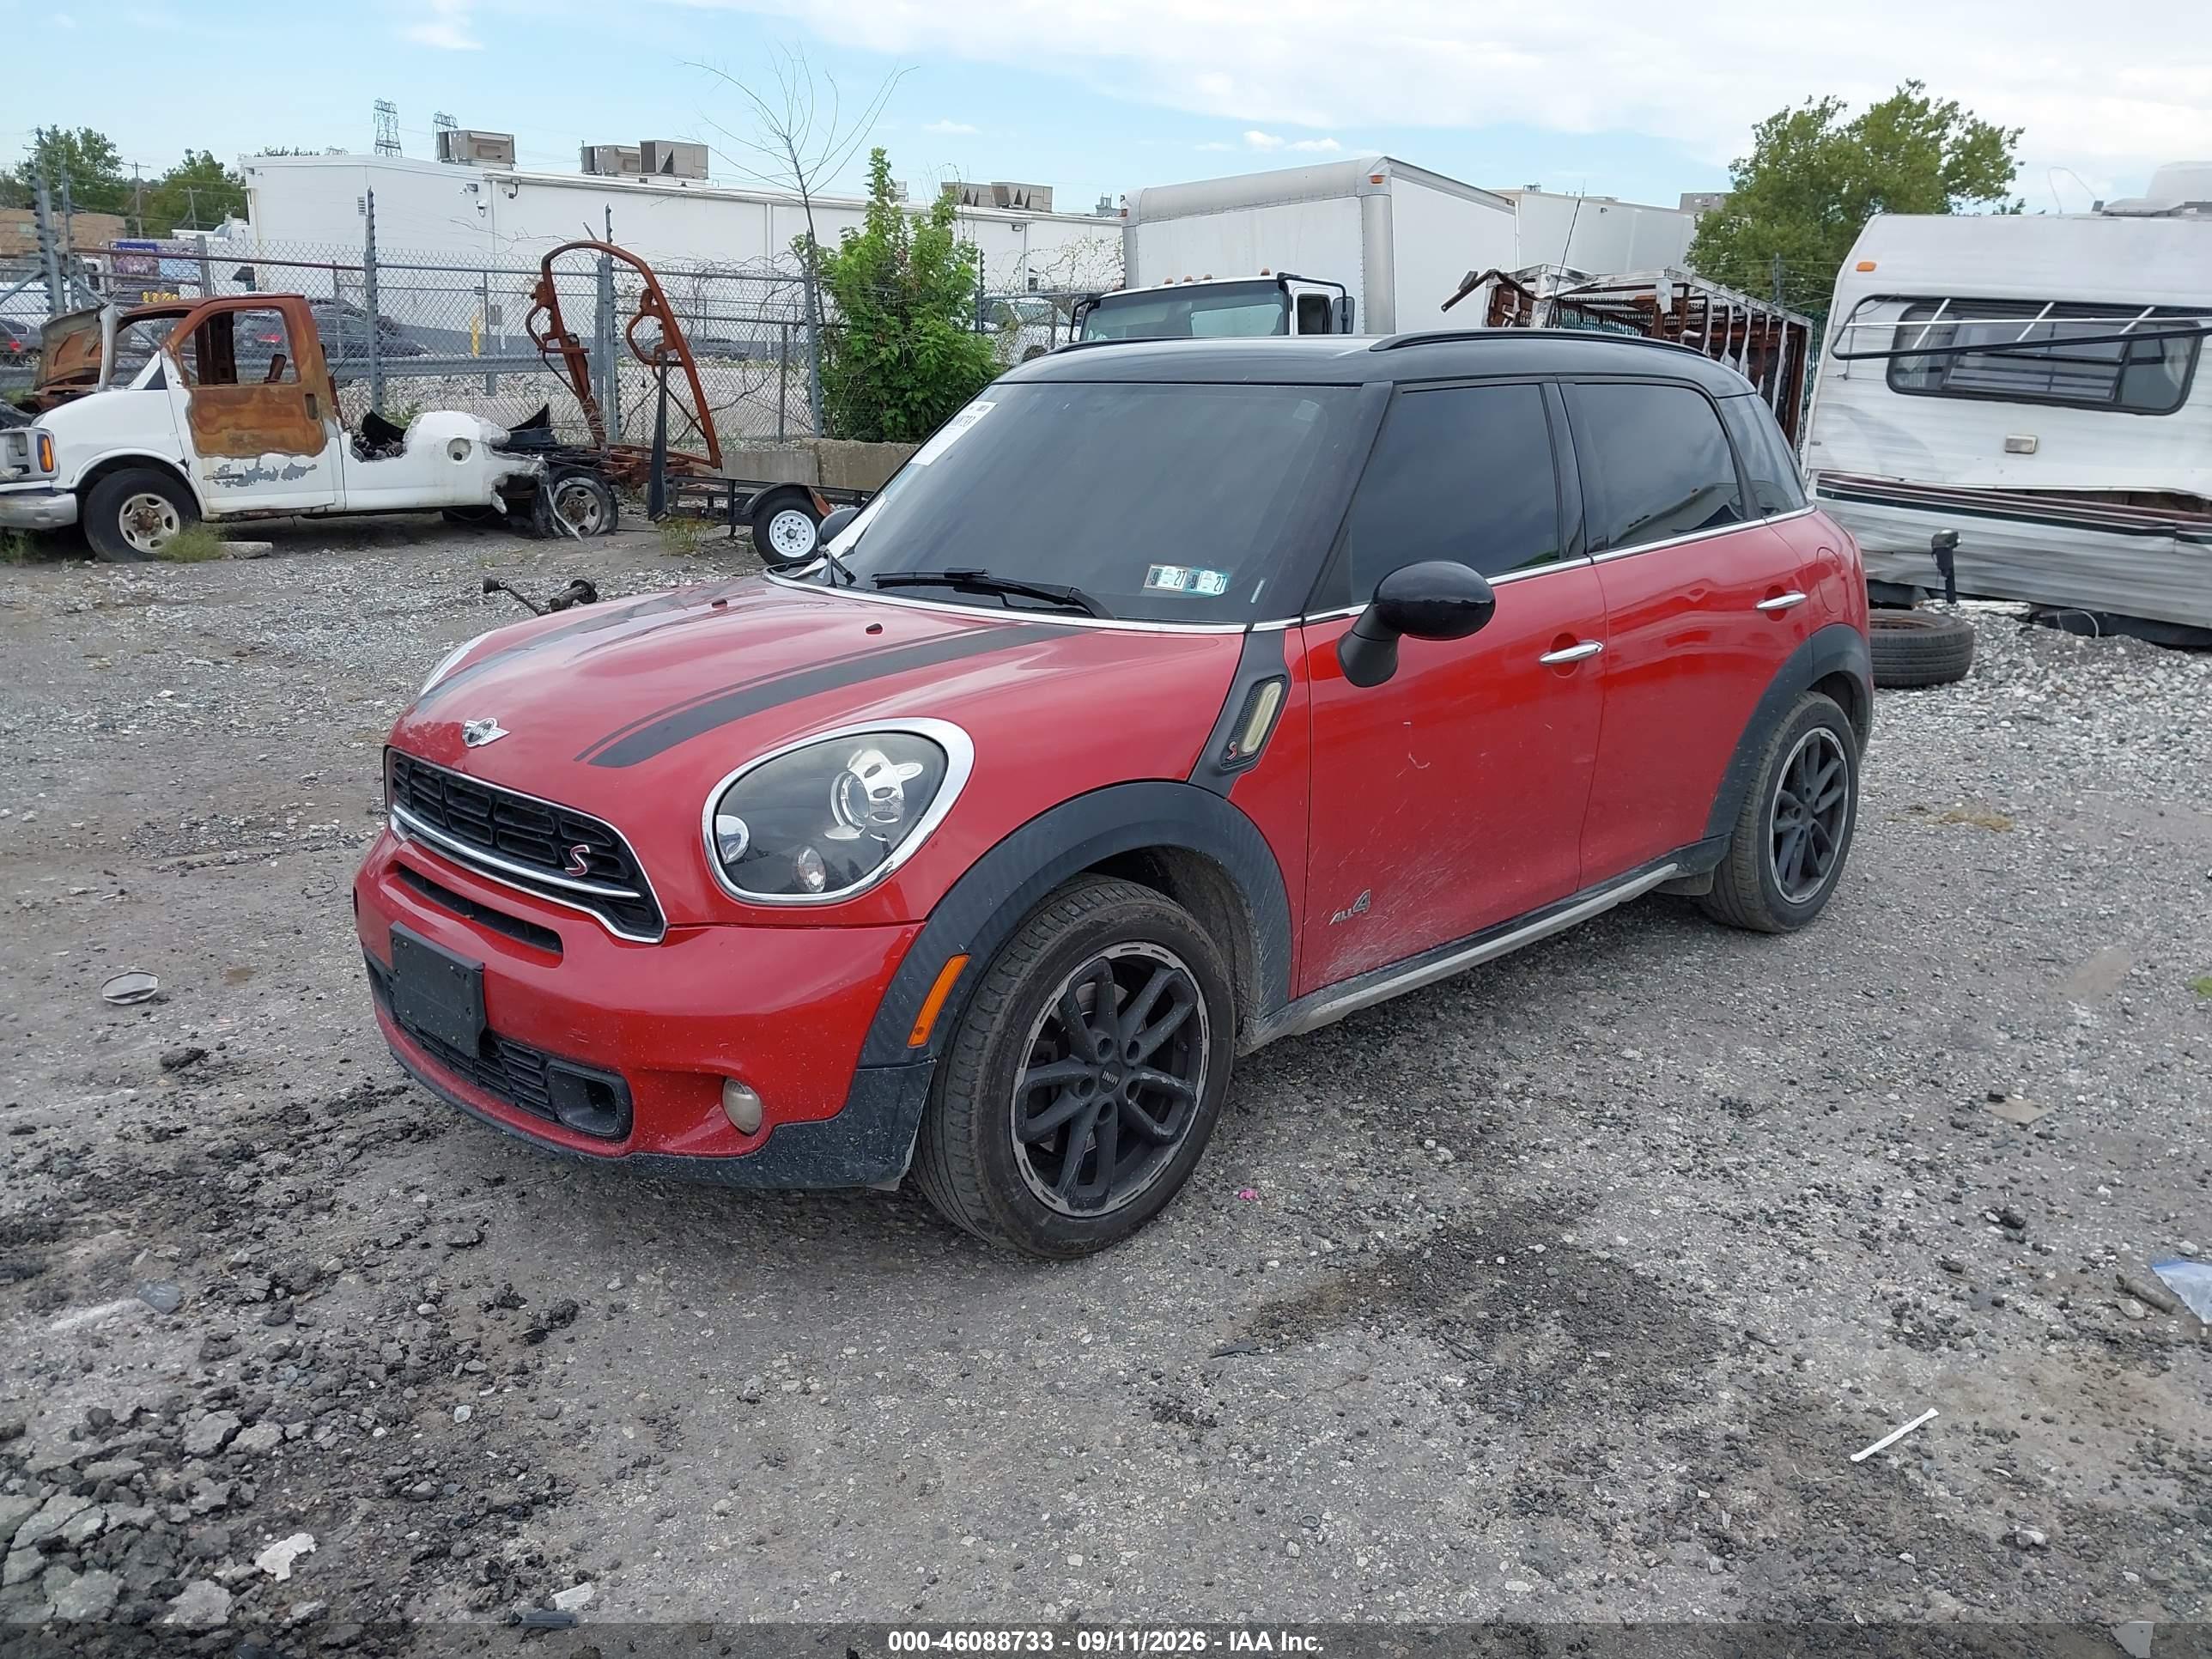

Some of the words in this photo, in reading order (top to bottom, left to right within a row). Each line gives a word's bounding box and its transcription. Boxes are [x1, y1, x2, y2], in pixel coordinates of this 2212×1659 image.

[1151, 571, 1159, 586] 9
[1174, 569, 1187, 587] 27
[1191, 574, 1198, 590] 9
[1213, 575, 1226, 592] 27
[564, 844, 591, 877] S
[1101, 1070, 1120, 1085] MINI
